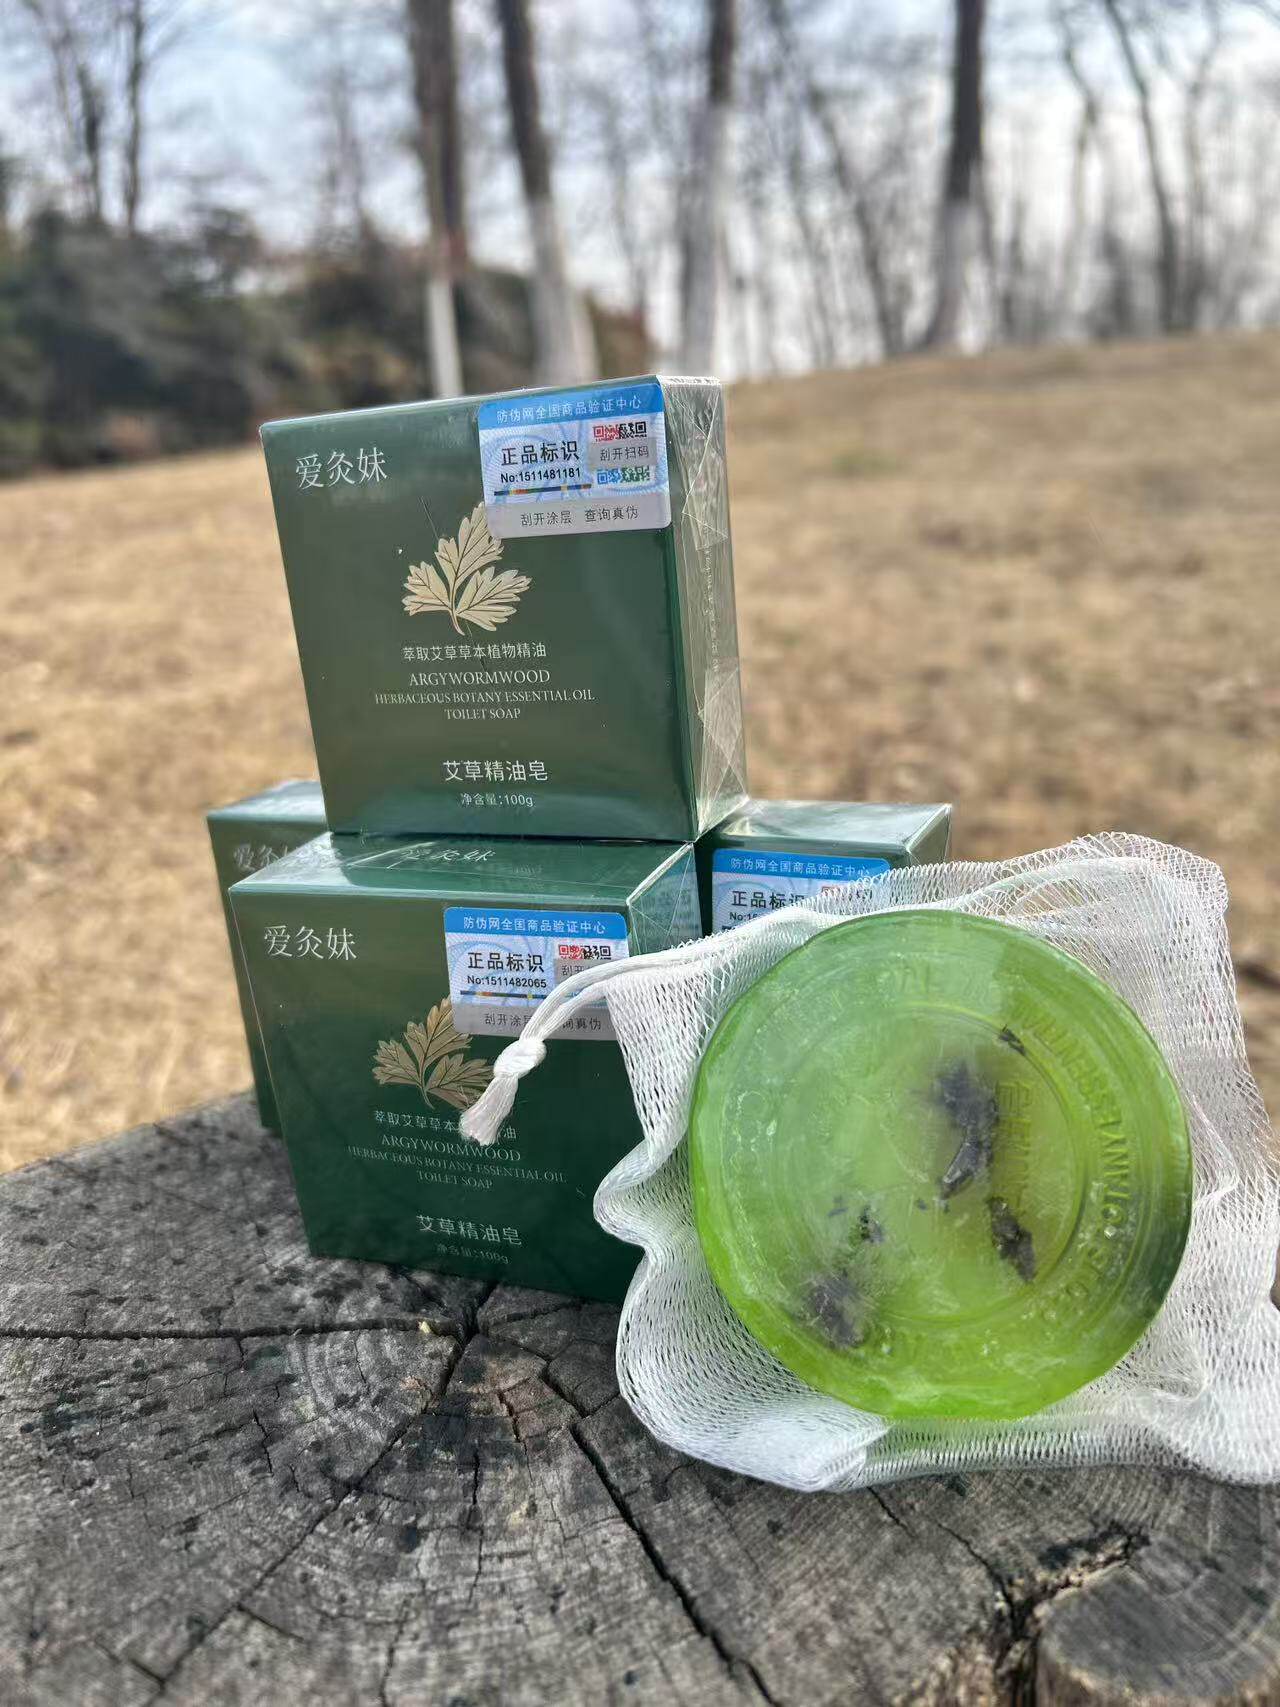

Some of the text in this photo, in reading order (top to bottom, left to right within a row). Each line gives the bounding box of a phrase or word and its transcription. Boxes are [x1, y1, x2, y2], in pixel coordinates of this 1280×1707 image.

[496, 396, 642, 423] 防伪网全国商品验证中心
[500, 440, 580, 466] 正品标识
[599, 445, 649, 461] 刮开扫码
[296, 447, 388, 490] 爱灸妹
[500, 467, 581, 483] No:1511481181
[521, 505, 639, 526] 刮开涂层 查询真伪
[402, 642, 547, 662] 萃取艾草草本植物精油
[409, 669, 551, 687] ARGYWORMWOOD
[375, 689, 596, 704] HERBACEOUS BOTANY ESSENTIAL OIL
[444, 707, 521, 720] TOILET SOAP
[443, 760, 548, 782] 艾草精油皂
[463, 916, 606, 934] 防伪网全国商品验证中心
[263, 925, 357, 960] 爱灸妹
[467, 952, 545, 973] 正品标识
[467, 975, 547, 988] No:1511482065
[416, 1214, 522, 1246] 艾草精油皂
